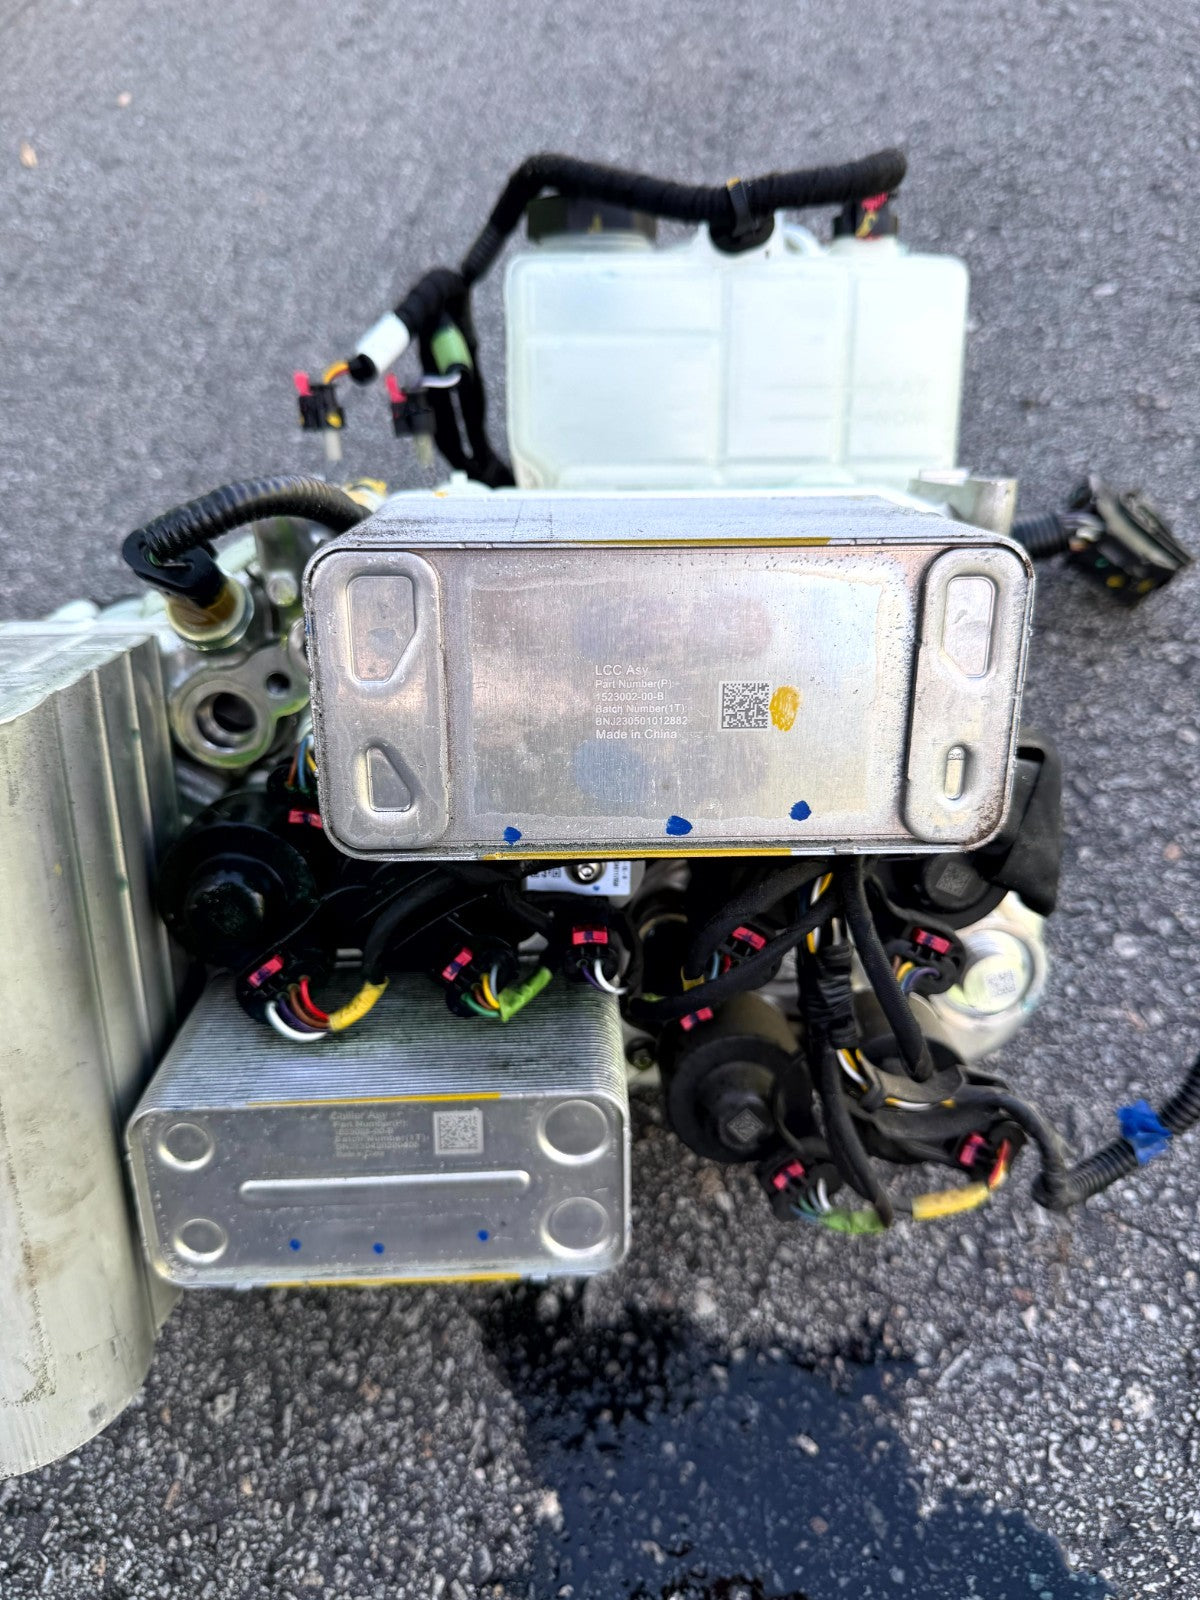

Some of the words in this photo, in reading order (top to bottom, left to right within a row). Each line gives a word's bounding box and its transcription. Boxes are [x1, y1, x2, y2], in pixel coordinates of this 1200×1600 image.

[595, 664, 622, 676] LCC
[626, 664, 649, 677] Asy
[595, 679, 615, 689] Part
[594, 691, 664, 702] 1523002-00-B
[595, 704, 622, 714] Batch
[595, 715, 688, 726] BNJ230501012882
[595, 729, 628, 740] Made
[631, 728, 641, 739] in
[644, 728, 678, 740] China
